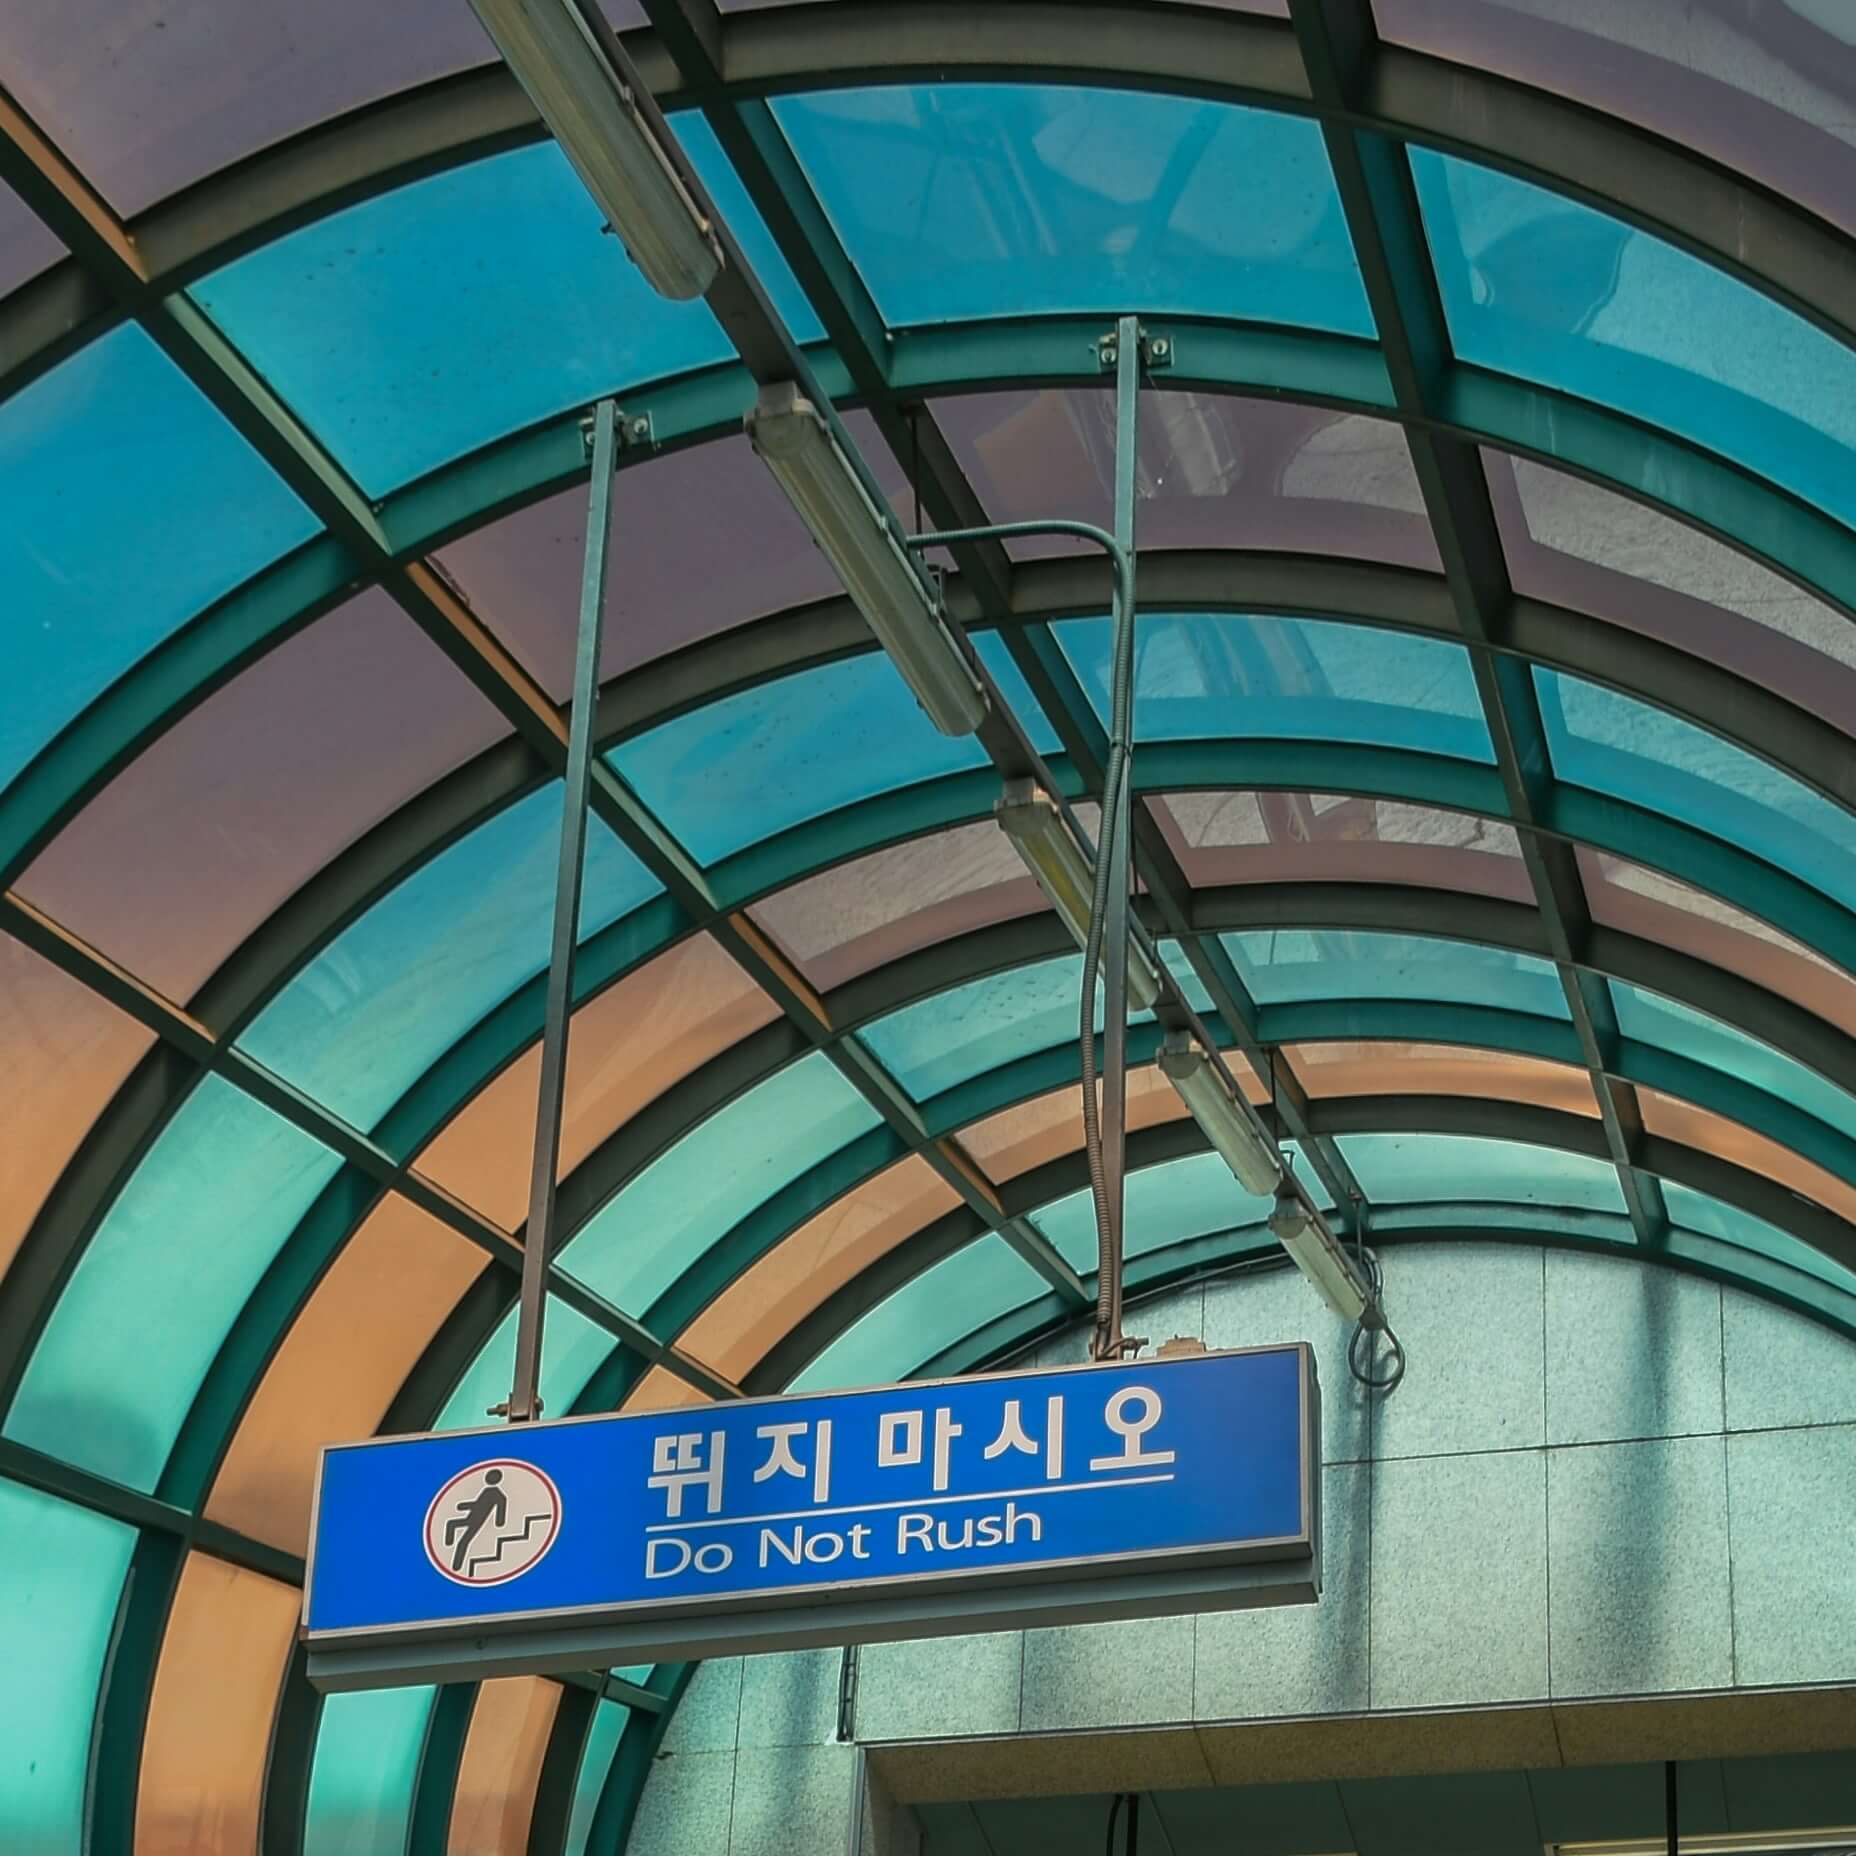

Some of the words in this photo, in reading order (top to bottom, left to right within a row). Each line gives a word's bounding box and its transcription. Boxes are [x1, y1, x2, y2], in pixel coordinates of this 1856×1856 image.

[646, 1420, 832, 1517] 뛰지
[878, 1386, 1176, 1490] 마시오
[645, 1539, 733, 1578] Do
[759, 1523, 872, 1567] Not
[897, 1503, 1041, 1554] Rush
